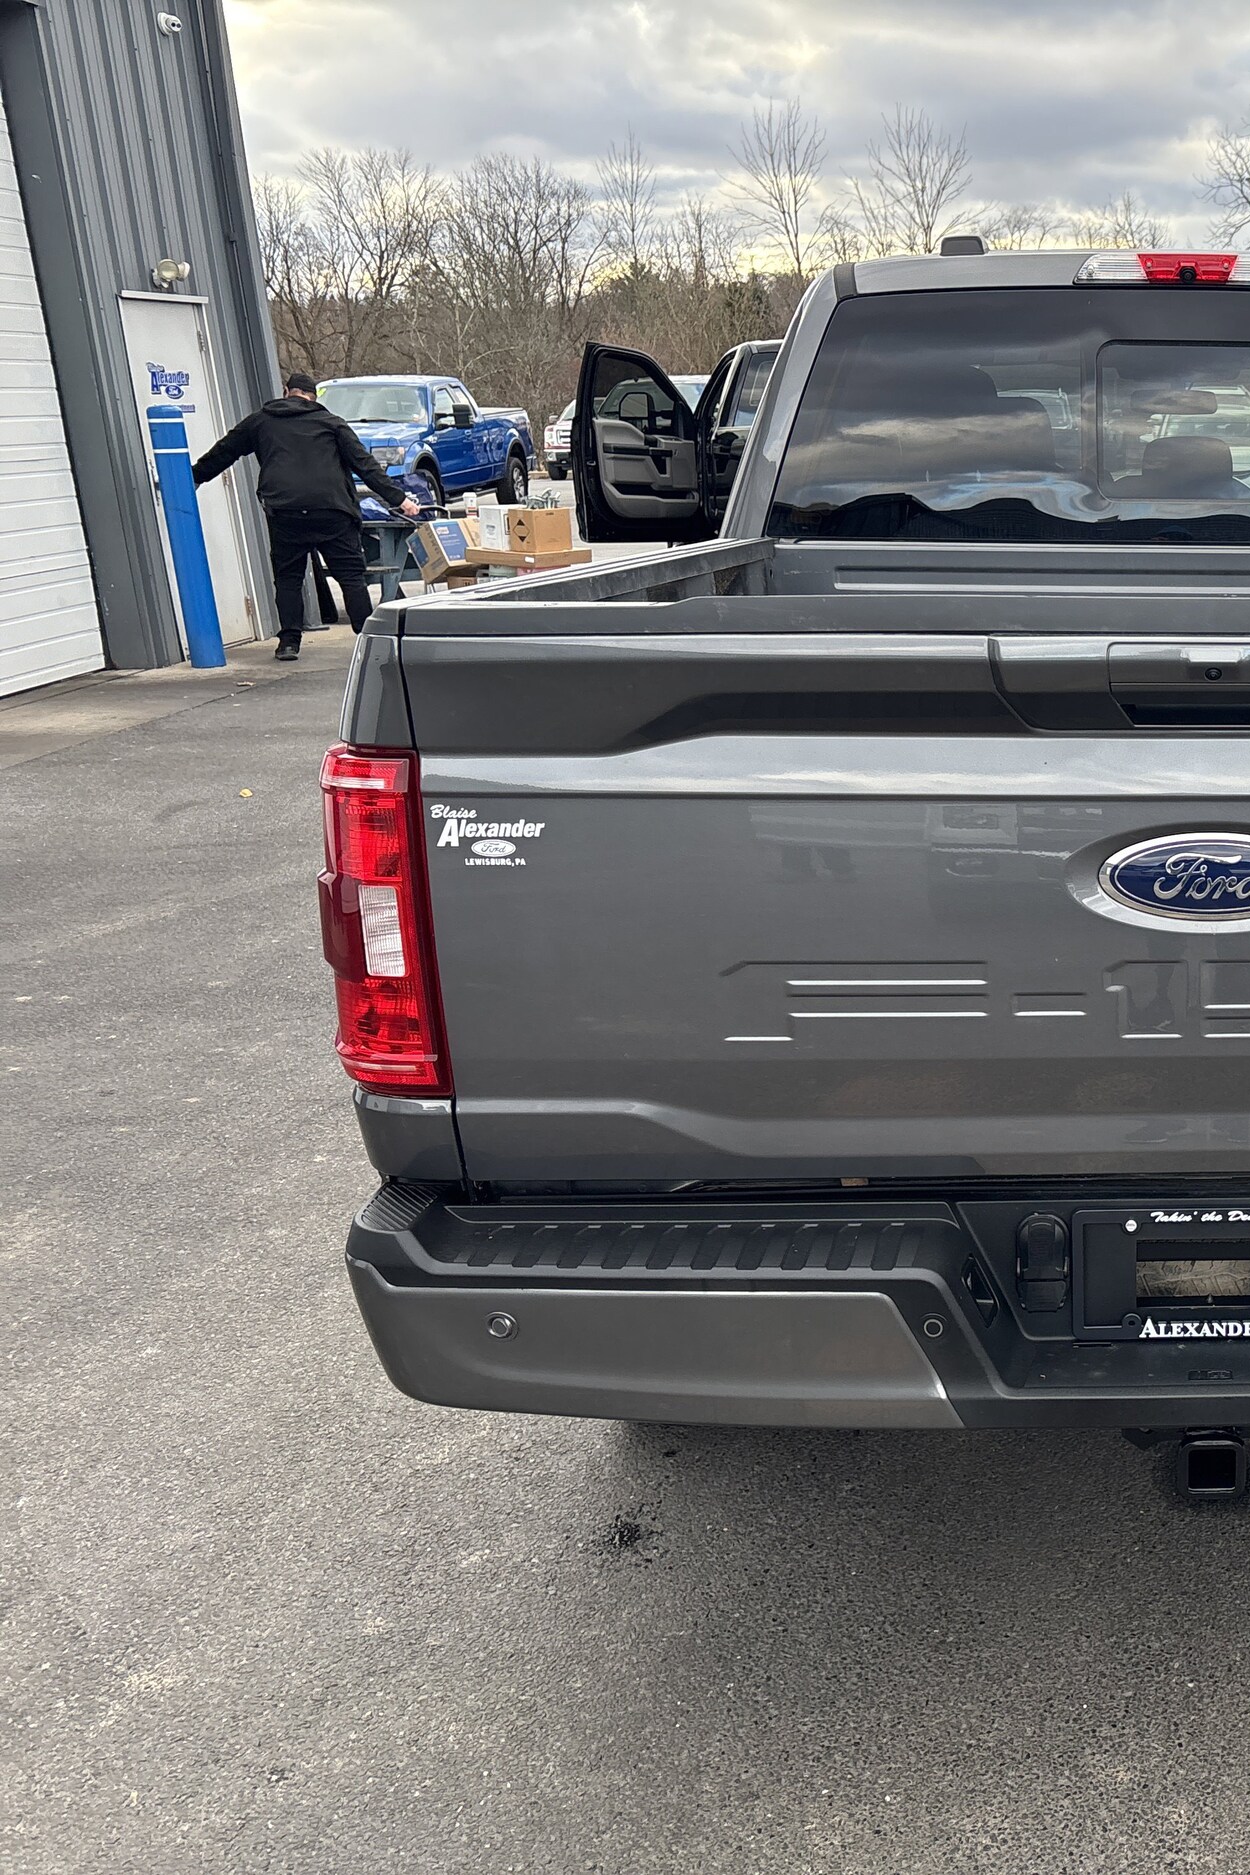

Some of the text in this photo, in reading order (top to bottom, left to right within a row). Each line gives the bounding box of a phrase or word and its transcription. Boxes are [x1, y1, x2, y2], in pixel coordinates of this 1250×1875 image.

[151, 371, 190, 393] Alexander
[430, 804, 477, 819] Blaise
[437, 819, 545, 847] Alexander
[481, 842, 506, 853] Ford
[465, 858, 526, 867] LEWISBURG, PA
[1150, 1210, 1198, 1223] Takin'
[1200, 1211, 1223, 1222] the
